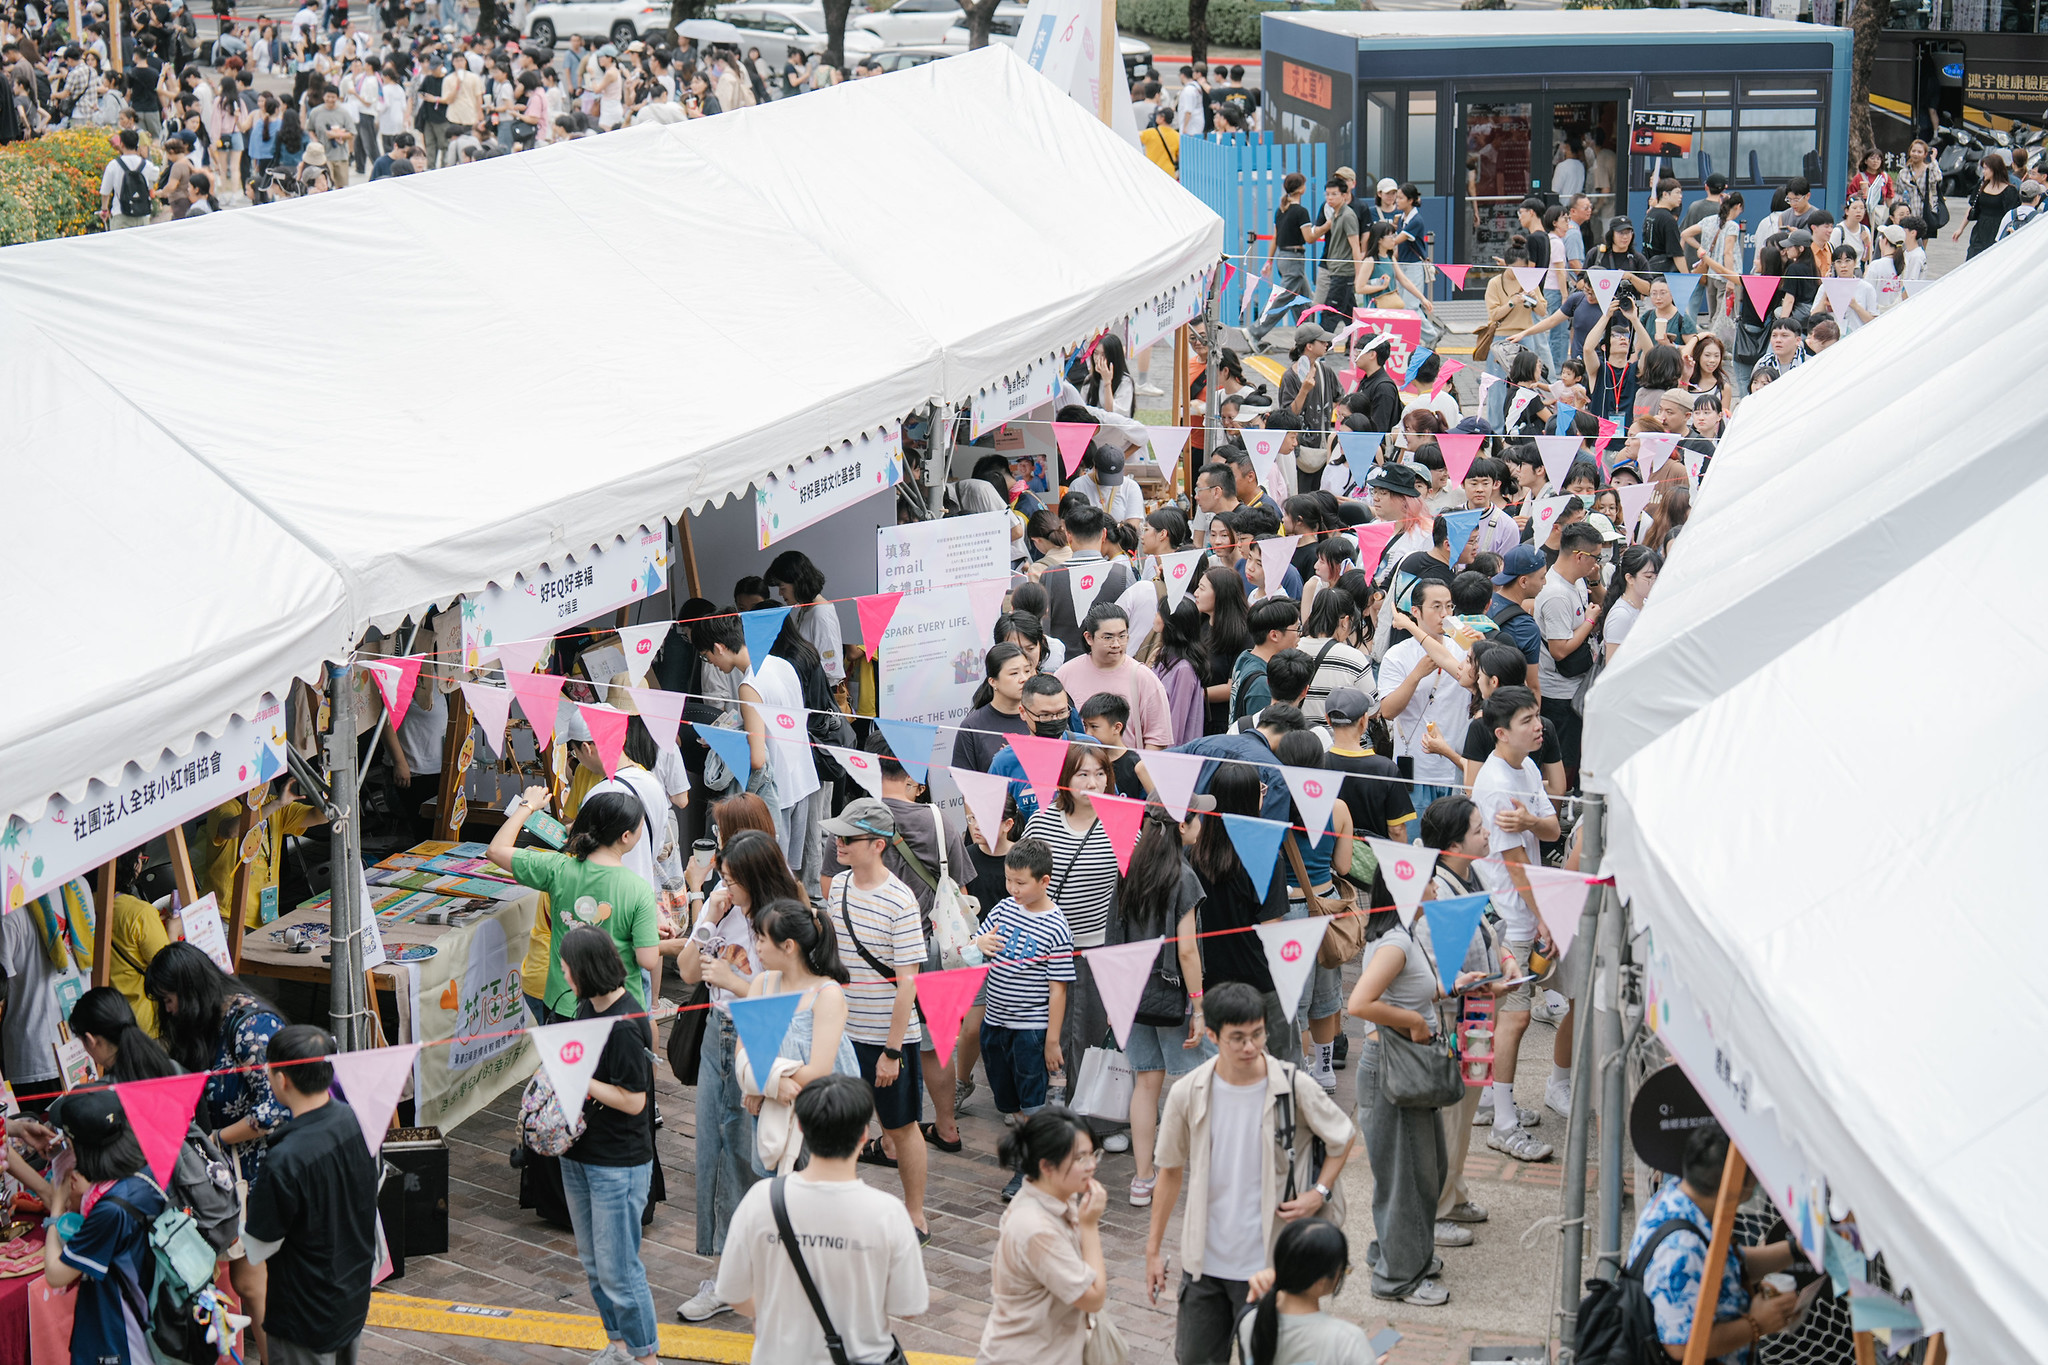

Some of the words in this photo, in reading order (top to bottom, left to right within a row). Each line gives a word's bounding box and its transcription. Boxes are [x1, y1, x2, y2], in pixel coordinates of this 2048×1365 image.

[1967, 91, 1986, 100] Hong
[1987, 92, 1995, 100] yu
[1997, 92, 2016, 101] home
[2017, 92, 2048, 102] Inspectio
[800, 461, 862, 504] 好好星球文化基金會
[885, 542, 911, 560] 填寫
[885, 559, 924, 577] email
[540, 565, 594, 604] 好EQ好幸福
[558, 598, 578, 618] 芯福里
[884, 625, 914, 639] SPARK
[917, 620, 946, 633] EVERY
[948, 617, 970, 628] LIFE.
[927, 709, 945, 721] THE
[948, 706, 970, 718] WOR
[73, 750, 222, 842] 社團法人全球小紅帽協會
